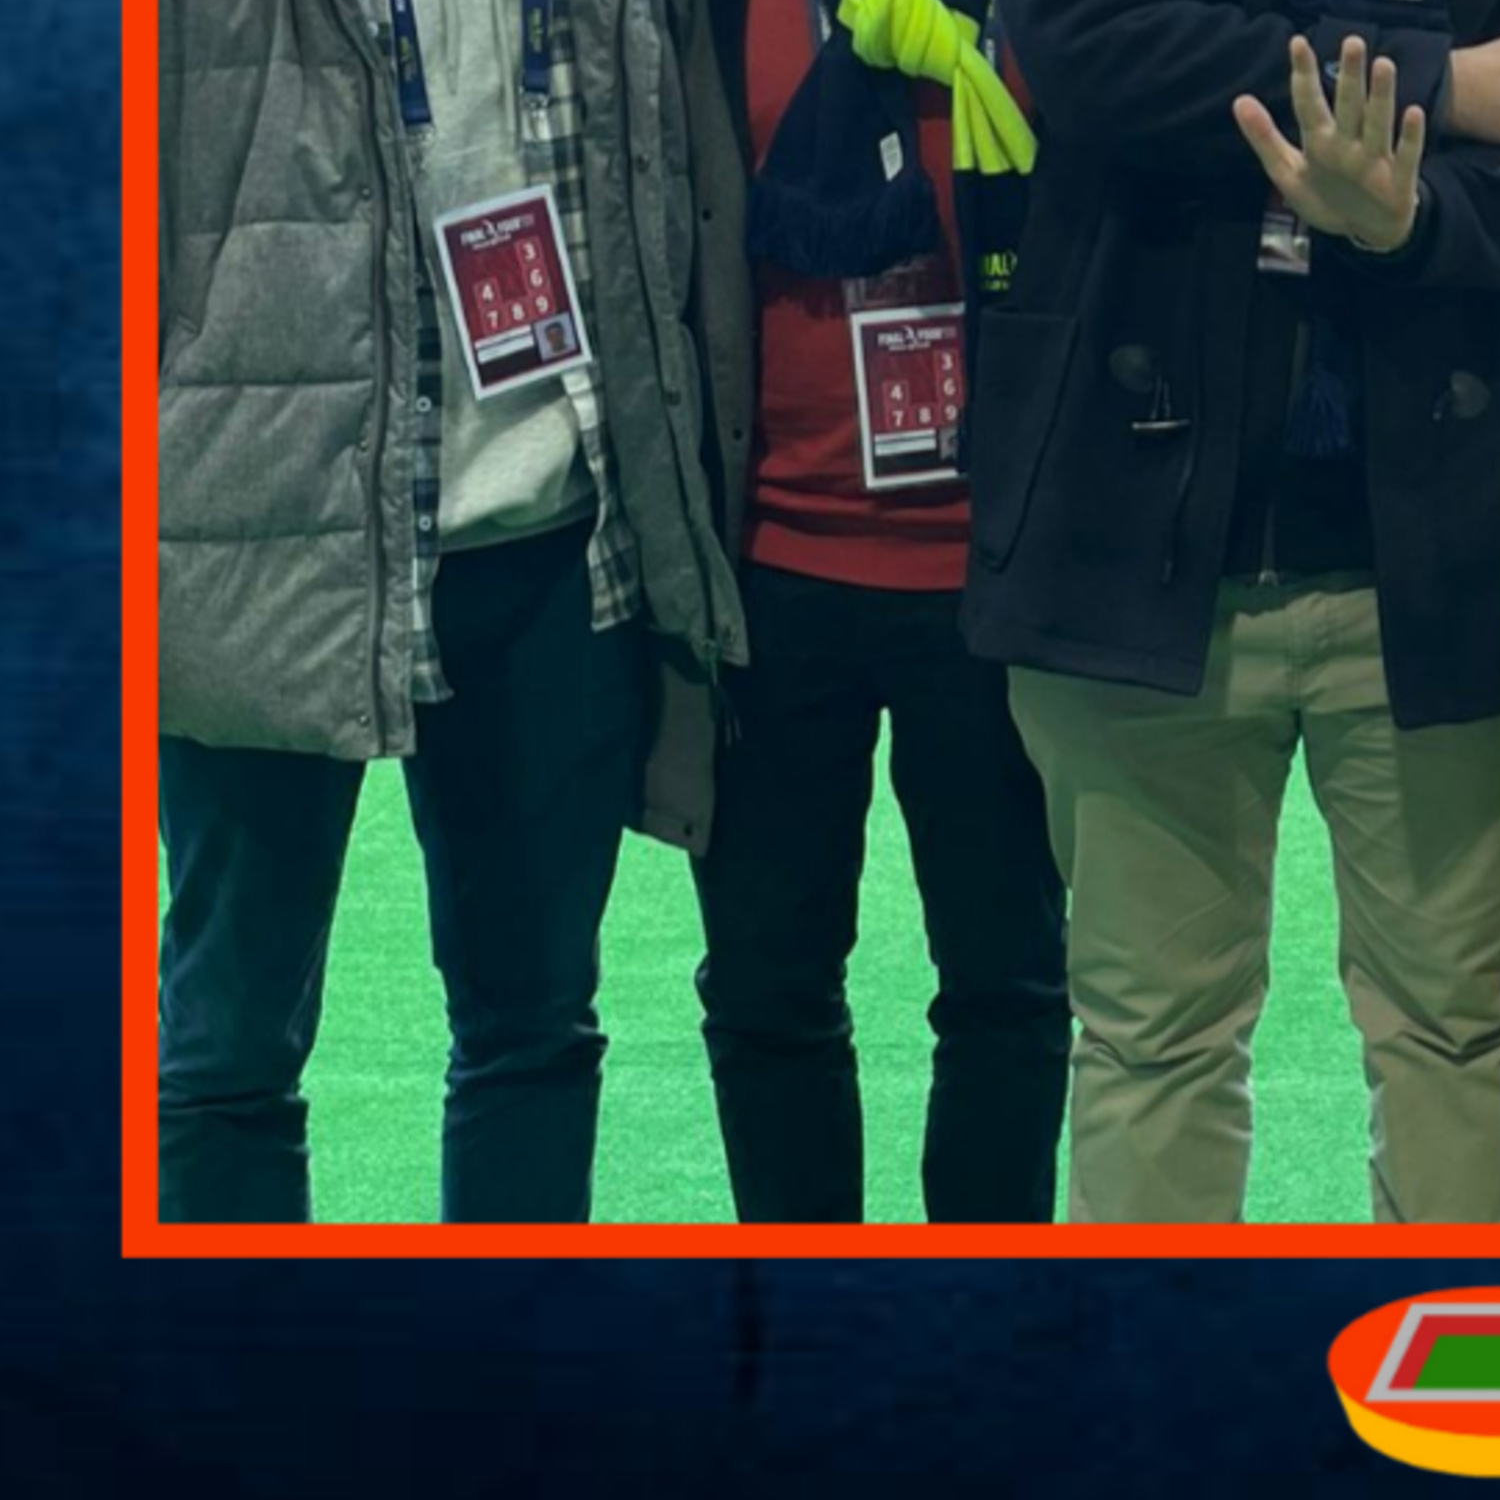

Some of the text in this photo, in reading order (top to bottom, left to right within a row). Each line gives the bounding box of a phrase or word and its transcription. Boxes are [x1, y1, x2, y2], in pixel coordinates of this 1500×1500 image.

[522, 244, 536, 260] 3
[482, 269, 543, 300] 4 6
[487, 297, 548, 328] 7 8 9
[942, 353, 953, 370] 3
[891, 379, 956, 400] 4 6
[892, 405, 957, 427] 7 8 9
